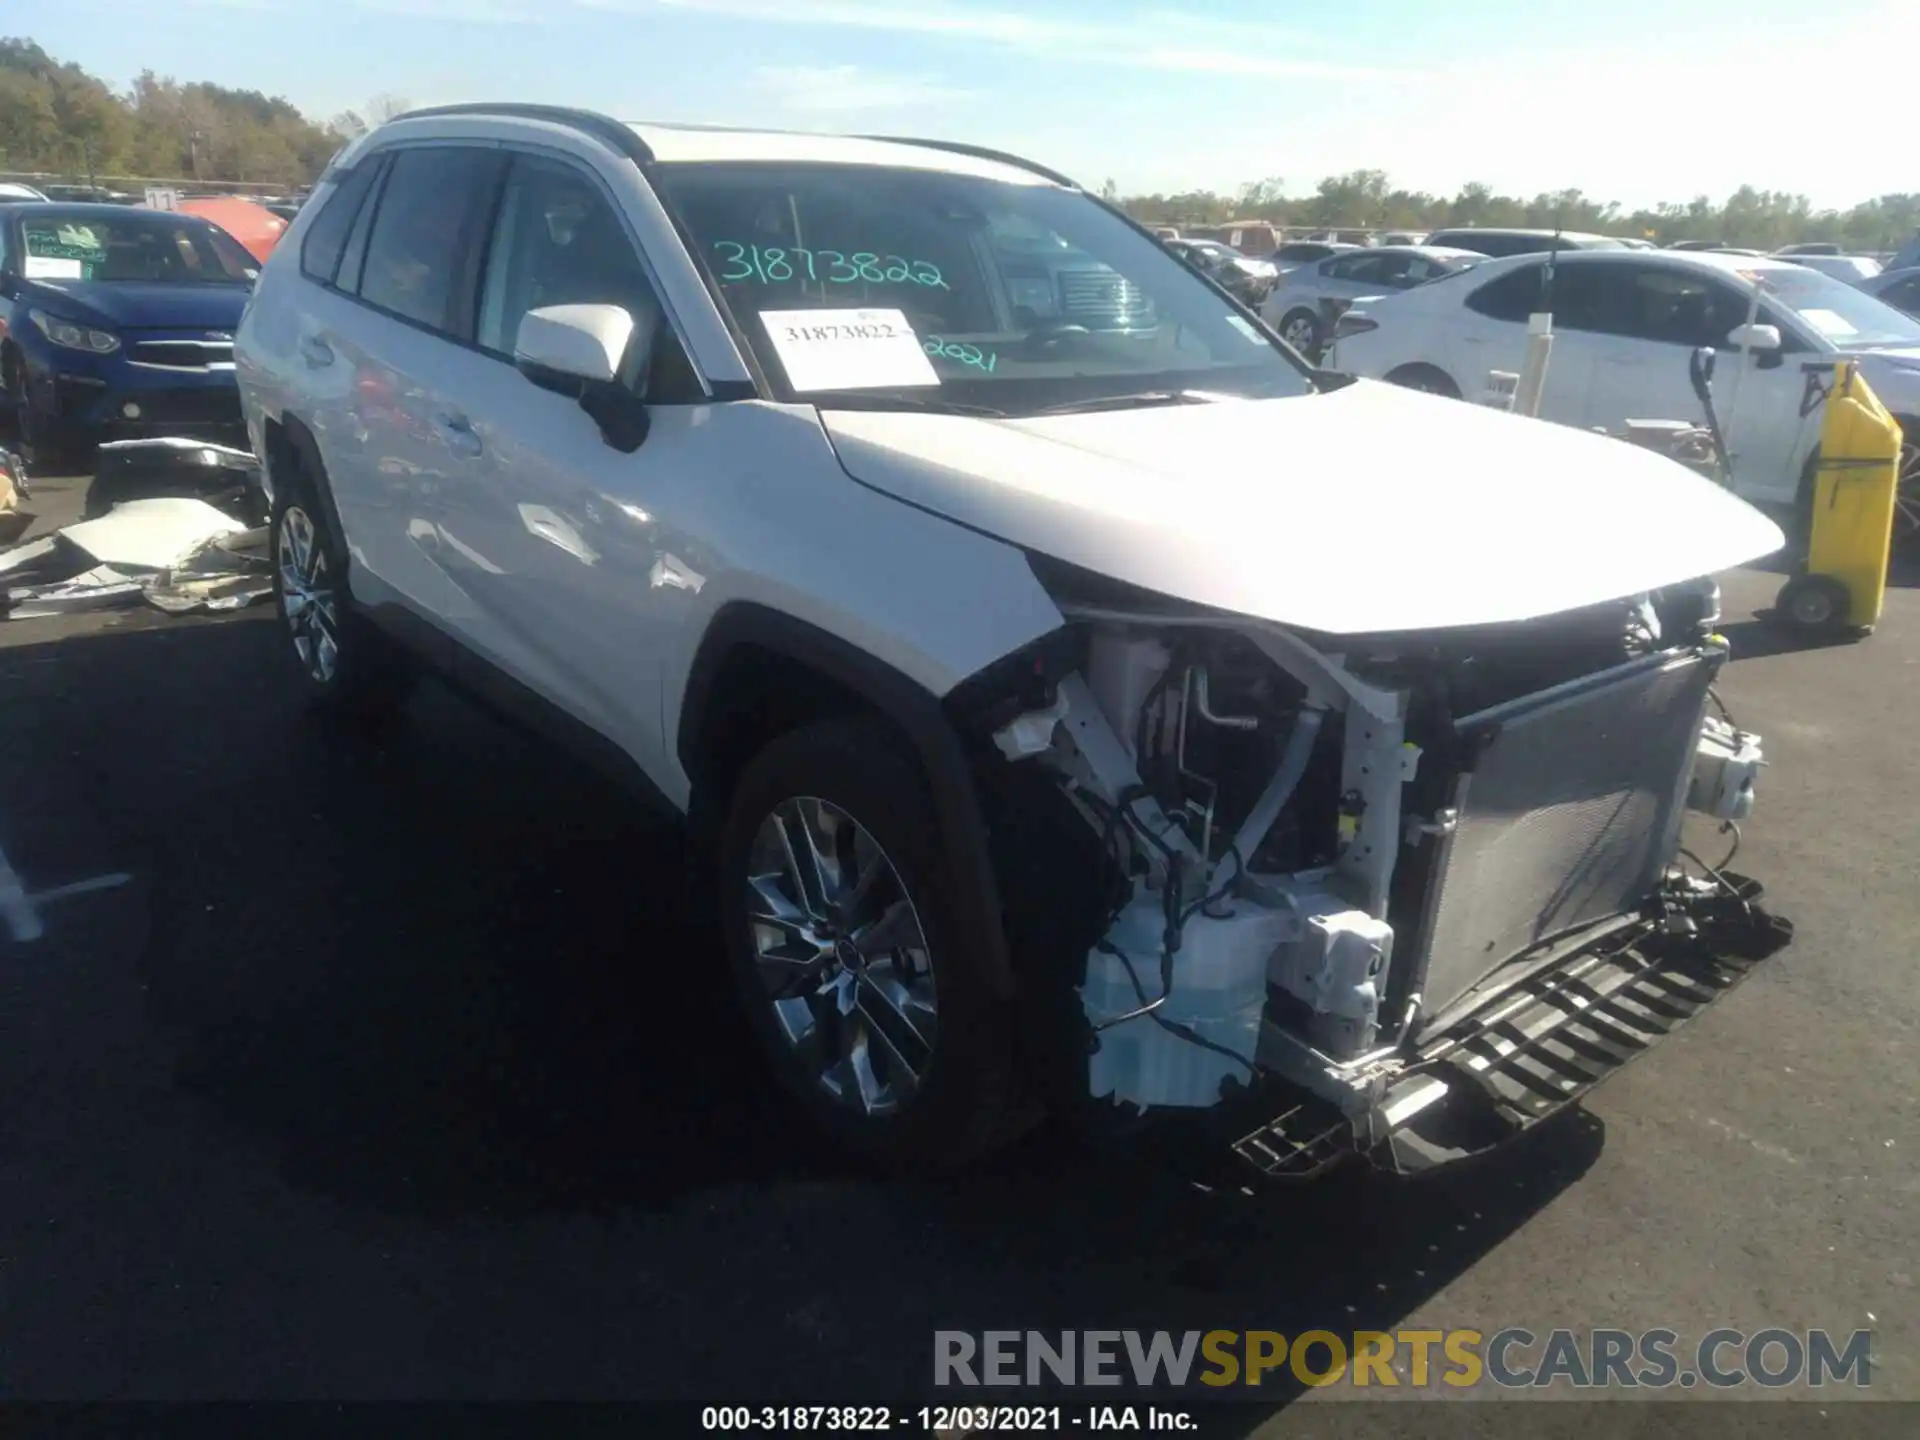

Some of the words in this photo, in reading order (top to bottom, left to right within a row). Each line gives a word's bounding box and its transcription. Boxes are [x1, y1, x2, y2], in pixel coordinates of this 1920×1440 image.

[714, 241, 950, 290] 31873822
[784, 324, 898, 342] 31873822
[922, 334, 997, 373] 2021
